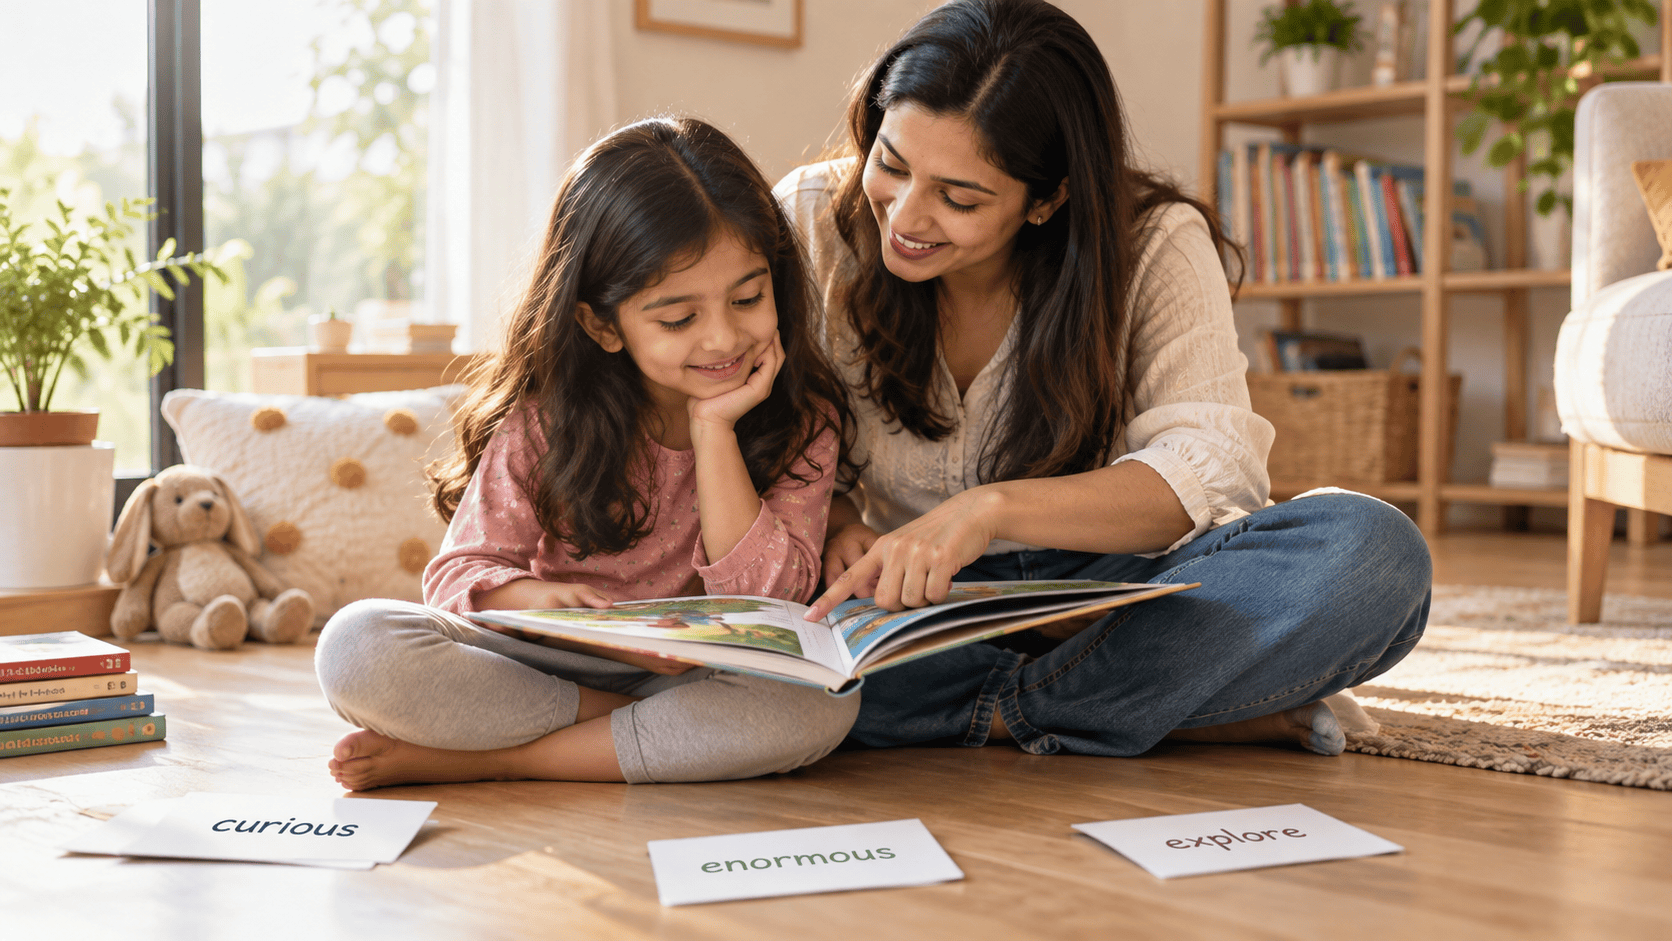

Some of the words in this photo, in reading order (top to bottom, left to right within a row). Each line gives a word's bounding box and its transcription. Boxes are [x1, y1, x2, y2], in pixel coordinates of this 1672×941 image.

[211, 817, 359, 838] curious
[1165, 827, 1307, 851] explore
[701, 847, 897, 873] enormous
